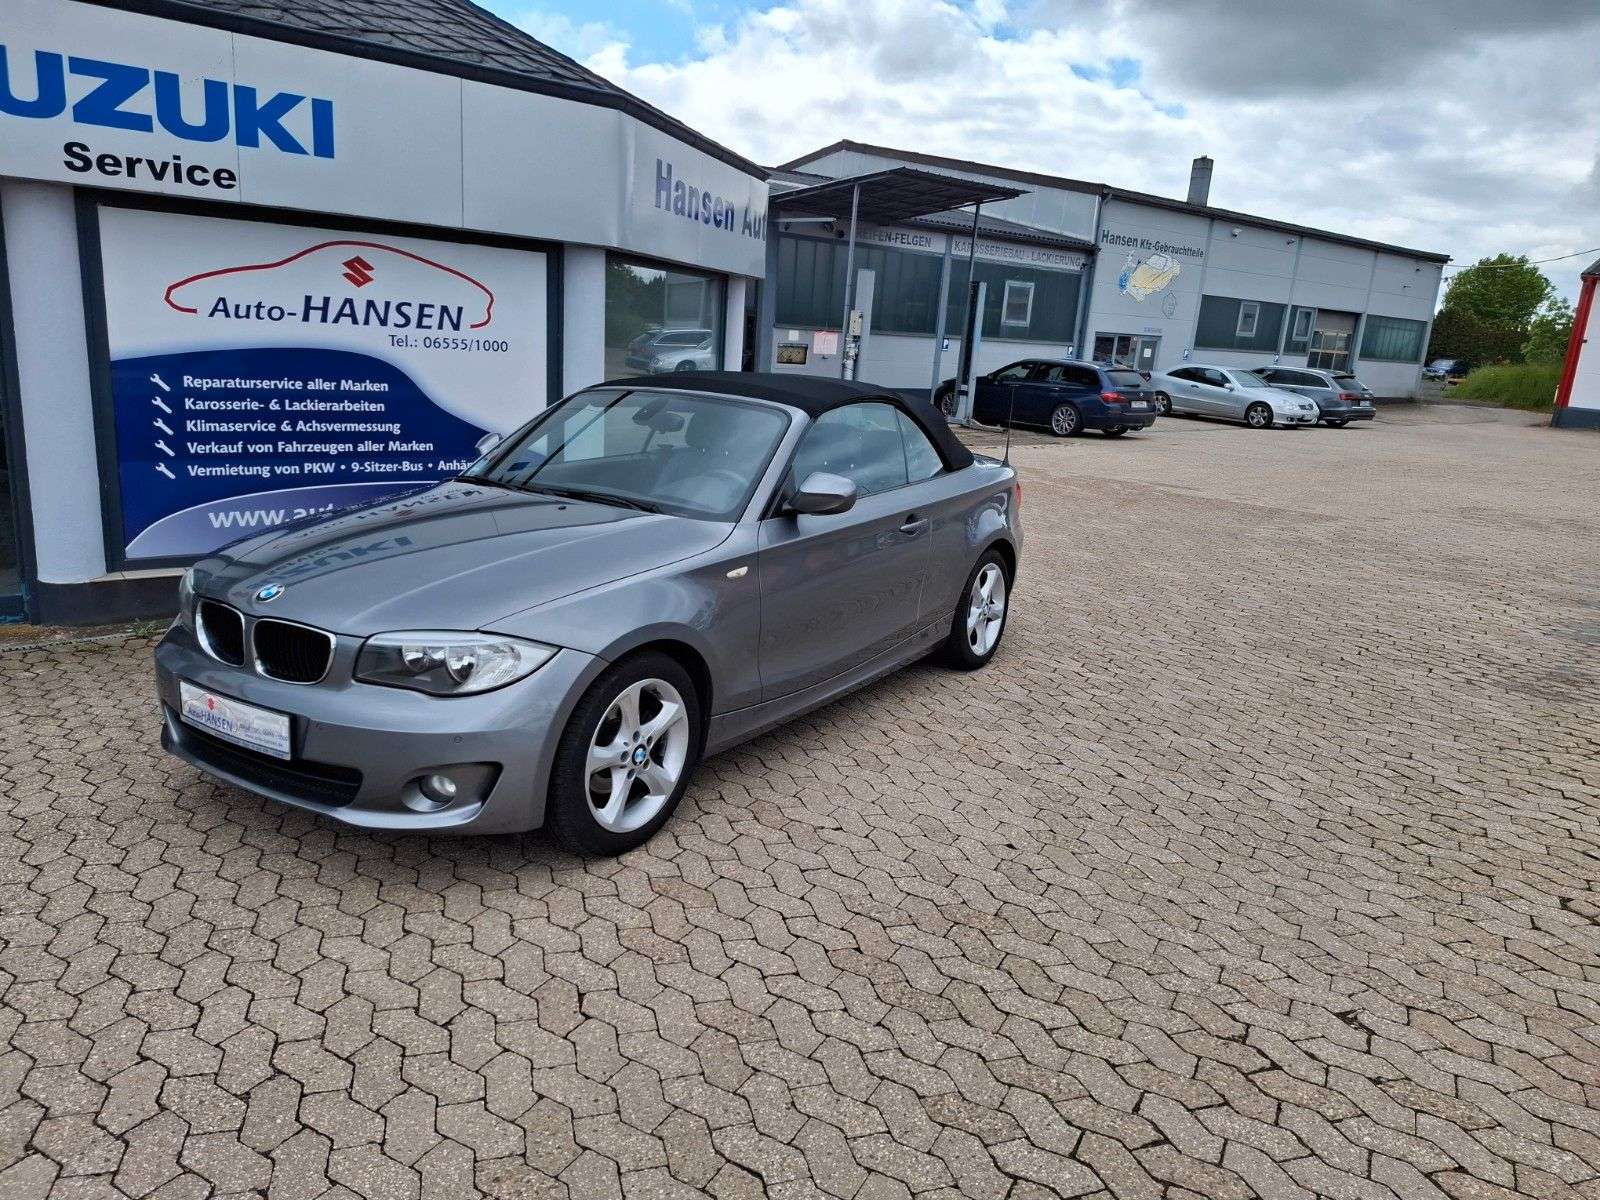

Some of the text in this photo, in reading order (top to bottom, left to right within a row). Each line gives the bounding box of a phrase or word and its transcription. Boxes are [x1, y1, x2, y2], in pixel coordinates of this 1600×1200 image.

[0, 44, 335, 159] UZUKI
[63, 141, 237, 190] Service
[655, 158, 735, 232] Hansen
[1101, 229, 1138, 248] Hansen
[208, 294, 464, 331] Auto-HANSEN
[388, 334, 508, 352] Tel.: 06555/1000
[183, 375, 389, 391] Reparaturservice aller Marken
[184, 398, 385, 412] Karosserie- & Lackierarbeiten
[186, 420, 401, 435] Klimaservice & Achsvermessung
[187, 440, 434, 455] Verkauf von Fahrzeugen aller Marken
[187, 464, 271, 478] Vermietung
[274, 465, 300, 475] von
[304, 462, 335, 474] PKW
[351, 460, 424, 472] 9-Sitzer-Bus
